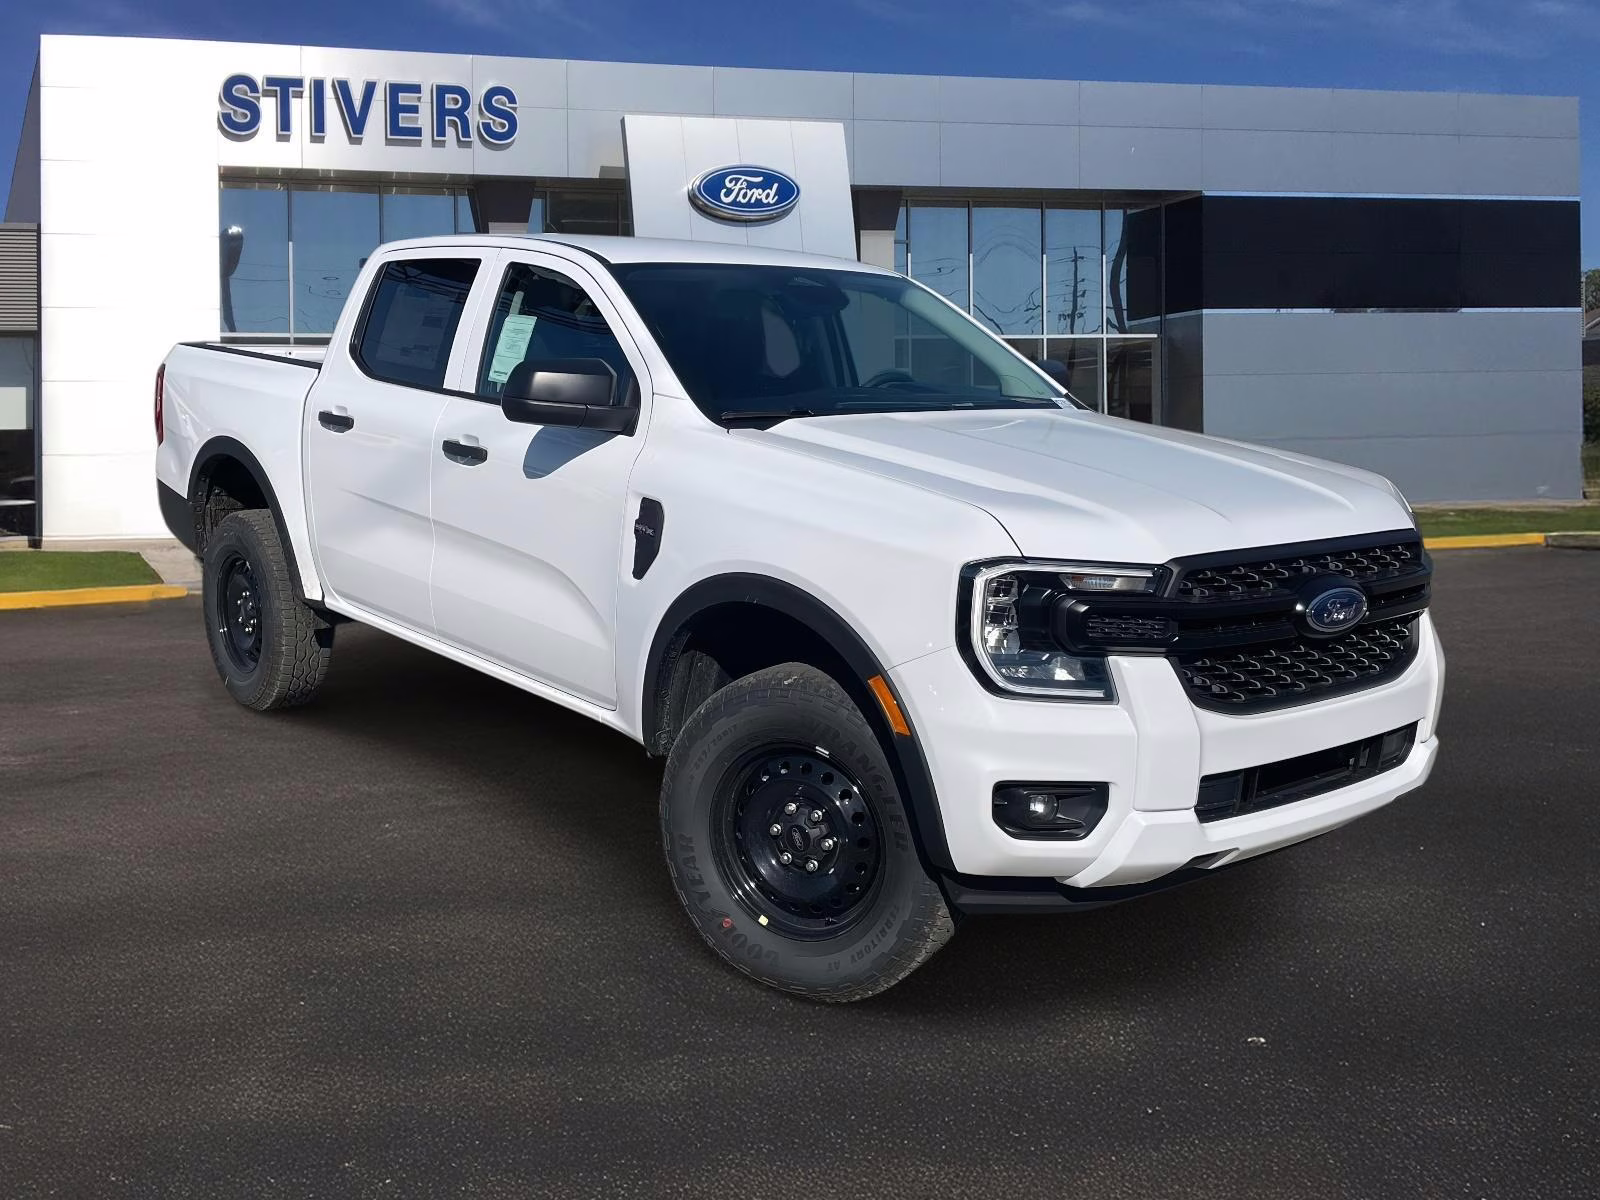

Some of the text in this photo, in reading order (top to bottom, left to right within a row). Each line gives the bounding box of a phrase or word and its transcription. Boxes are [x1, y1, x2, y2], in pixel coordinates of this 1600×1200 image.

[218, 73, 519, 144] STIVERS
[720, 174, 779, 204] Ford
[1323, 598, 1358, 623] Ford
